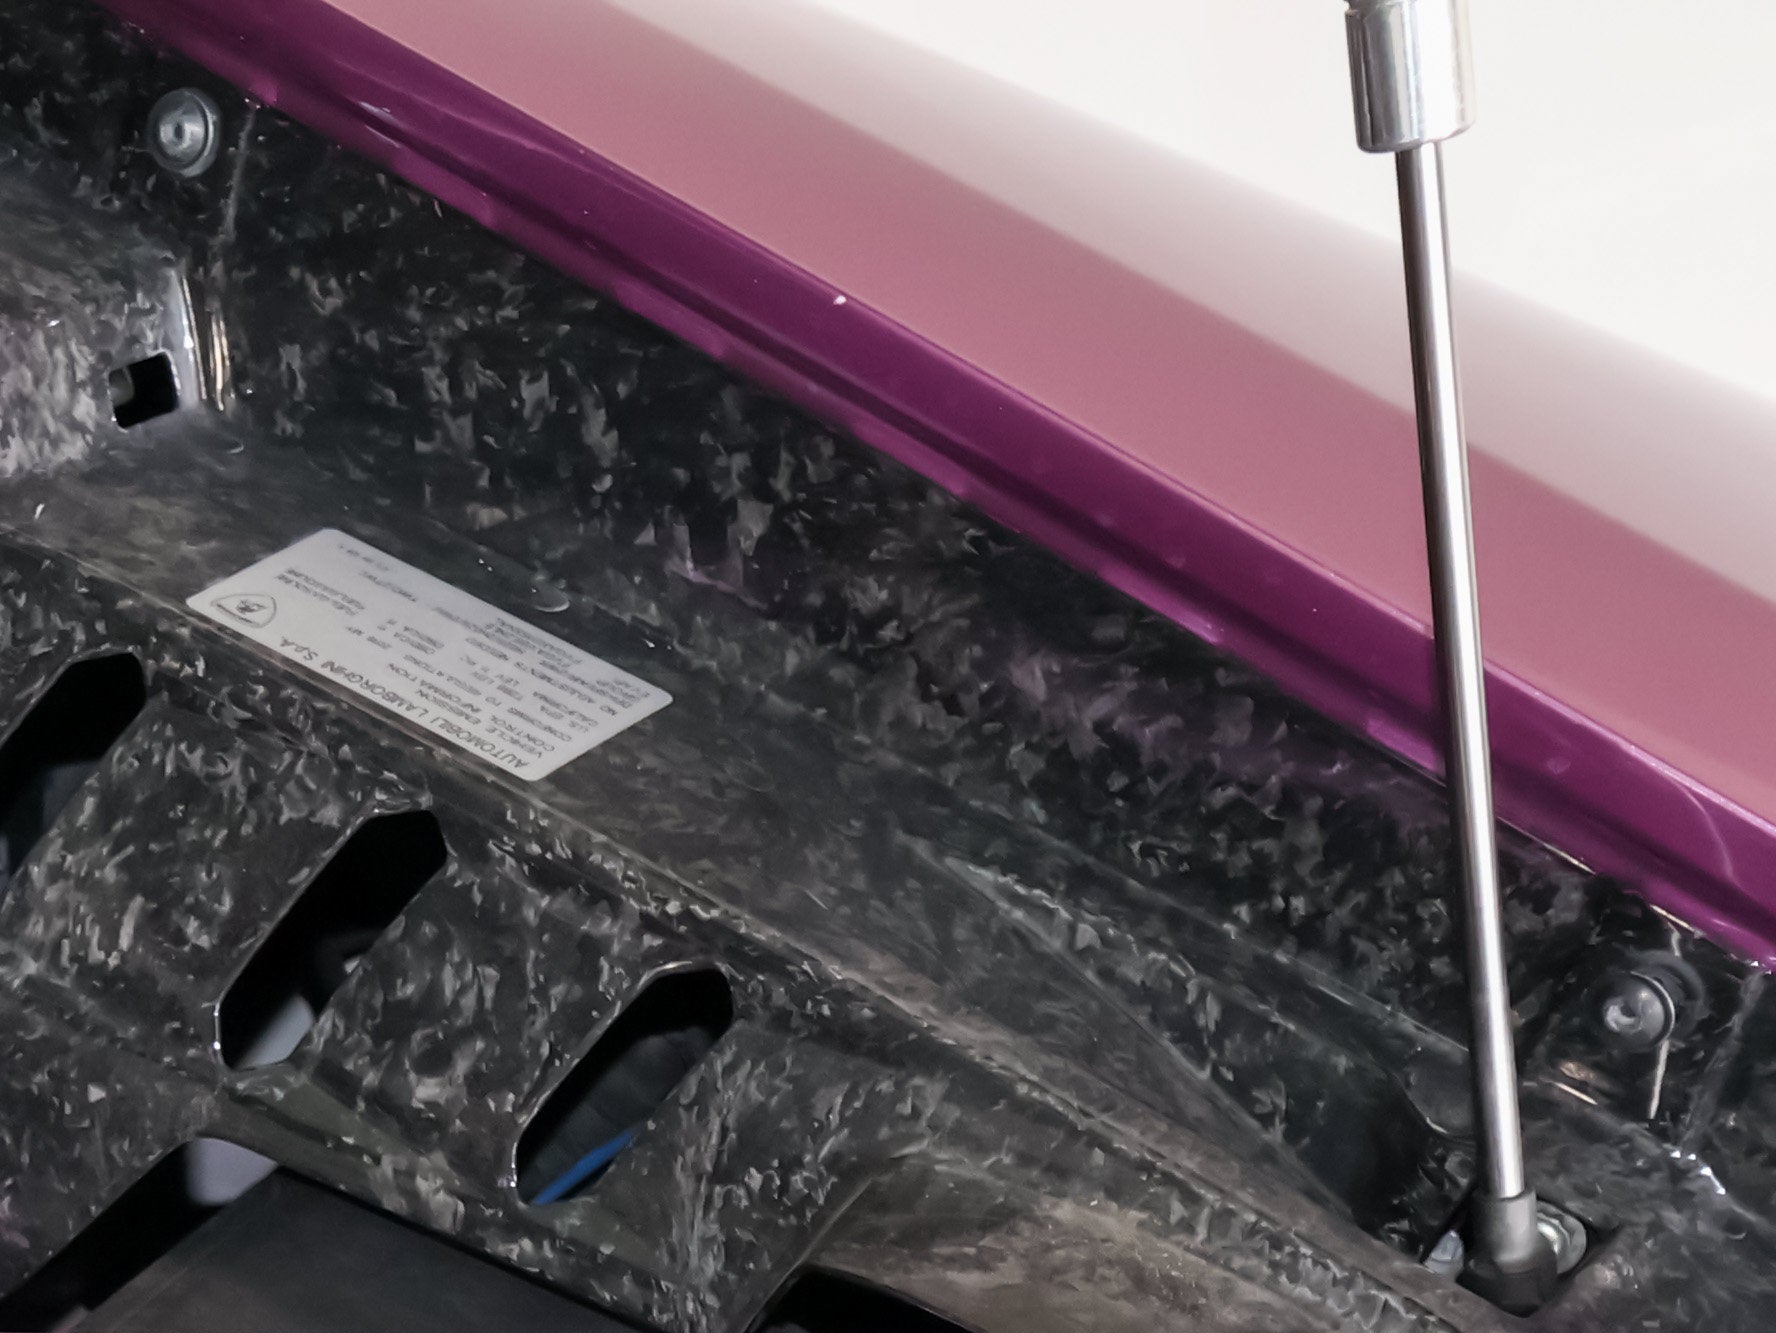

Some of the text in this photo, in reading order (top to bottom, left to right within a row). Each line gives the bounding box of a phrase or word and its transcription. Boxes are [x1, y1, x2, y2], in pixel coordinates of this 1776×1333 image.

[319, 659, 430, 717] LAMBORGHINI
[383, 662, 557, 751] CONTROL INFORMATION
[428, 715, 531, 769] AUTOMOBILI
[483, 725, 547, 758] VEHICLE
